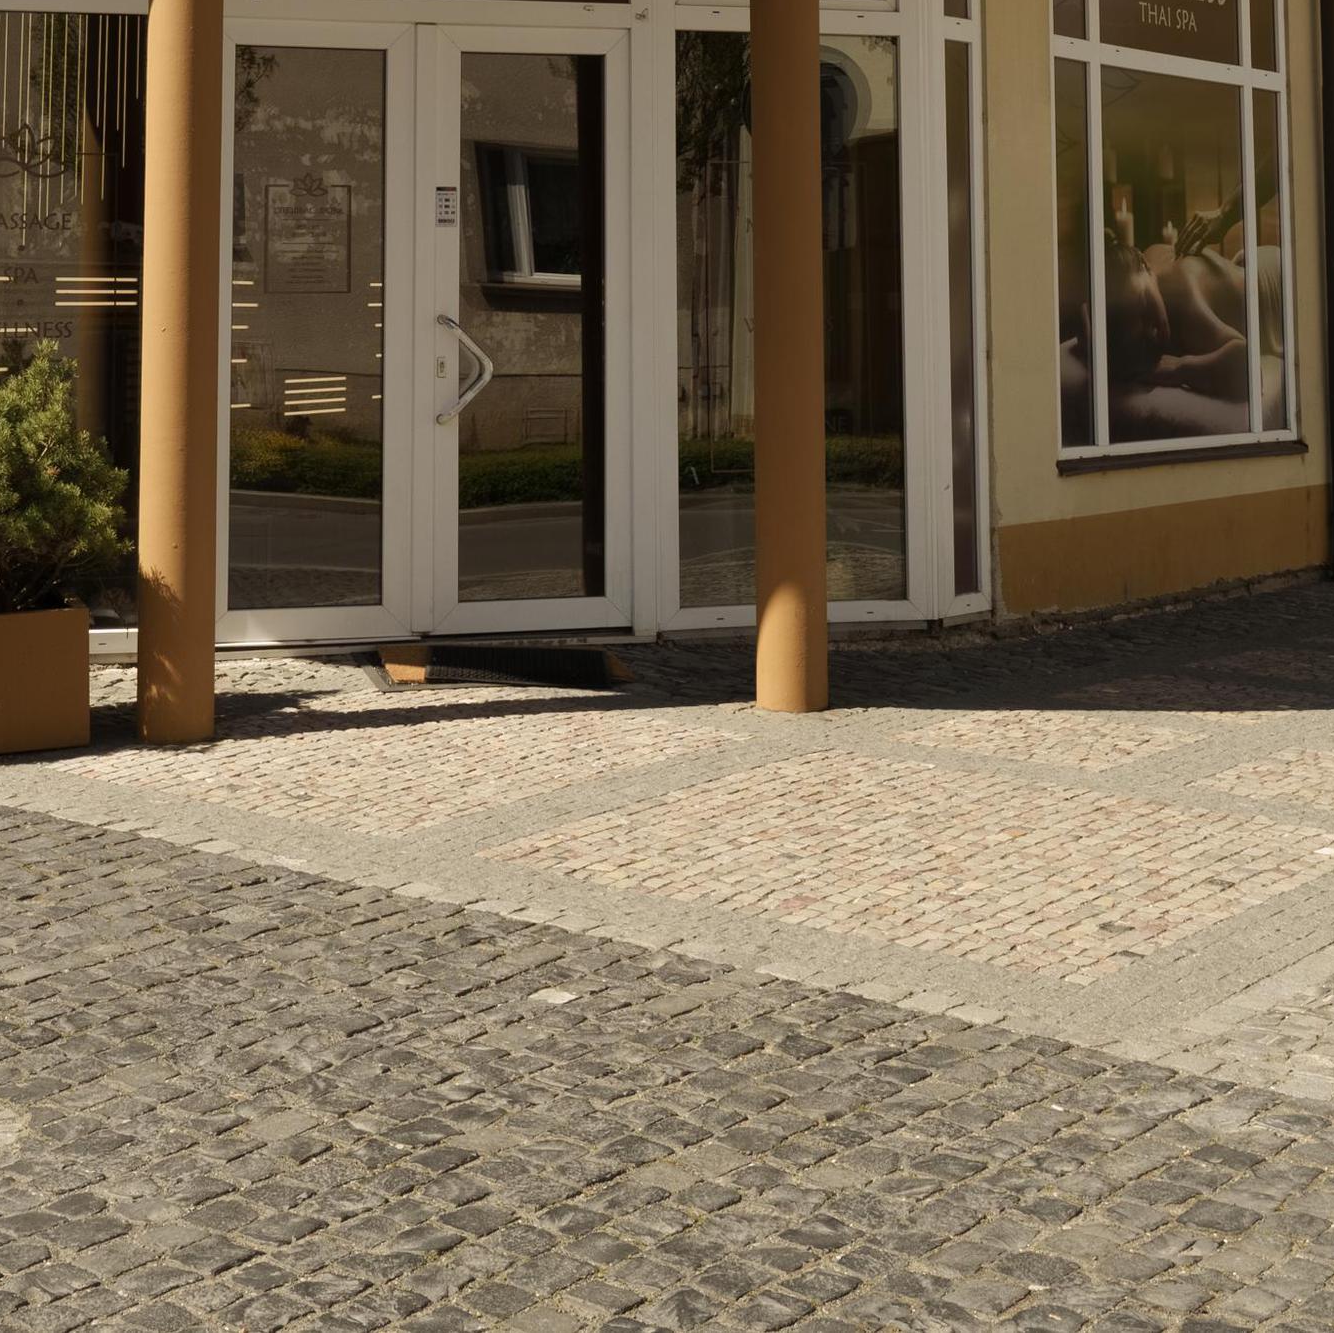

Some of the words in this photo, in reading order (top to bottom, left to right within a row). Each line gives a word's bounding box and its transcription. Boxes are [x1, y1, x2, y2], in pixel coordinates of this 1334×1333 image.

[1139, 1, 1171, 28] THAI
[1176, 8, 1198, 33] SPA
[2, 266, 39, 284] SPA
